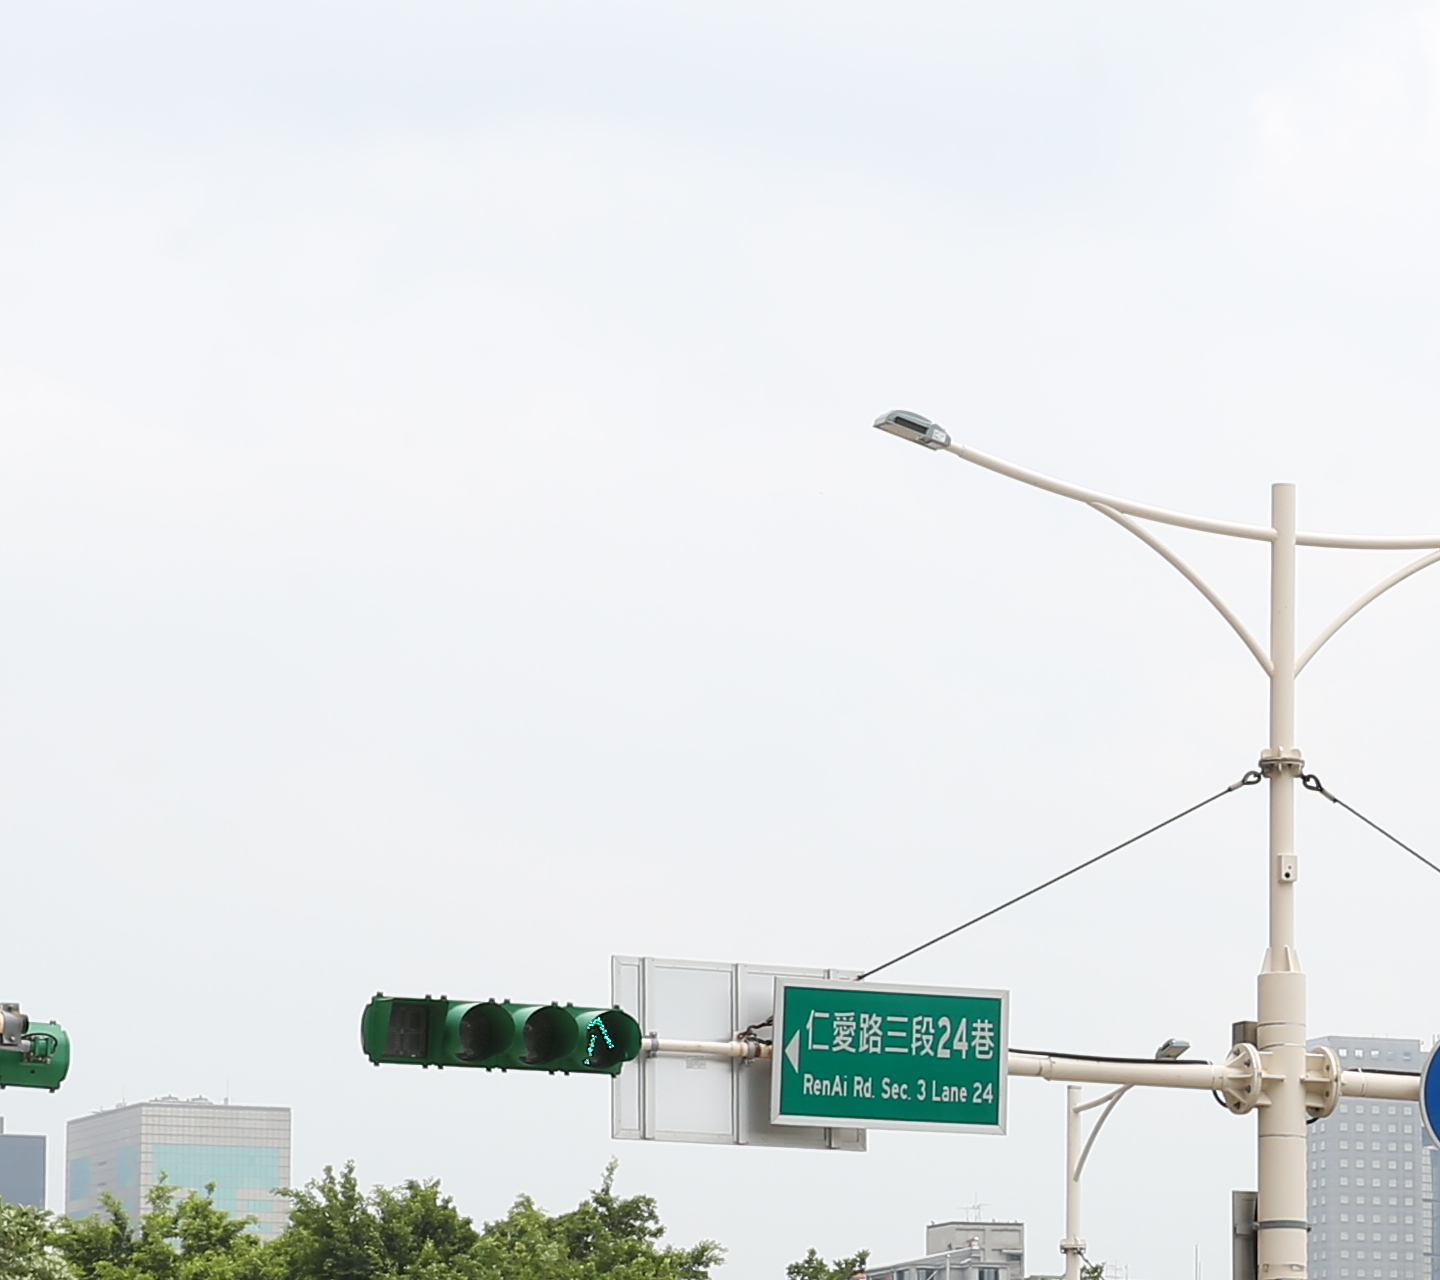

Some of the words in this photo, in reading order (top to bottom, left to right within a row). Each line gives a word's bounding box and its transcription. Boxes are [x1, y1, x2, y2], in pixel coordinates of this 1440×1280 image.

[805, 1009, 995, 1060] 仁愛路三段24巷
[803, 1073, 848, 1097] RenAi
[853, 1076, 875, 1099] Rd.
[881, 1077, 911, 1101] Sec.
[917, 1079, 927, 1101] 3
[932, 1080, 968, 1103] Lane
[972, 1082, 993, 1104] 24
